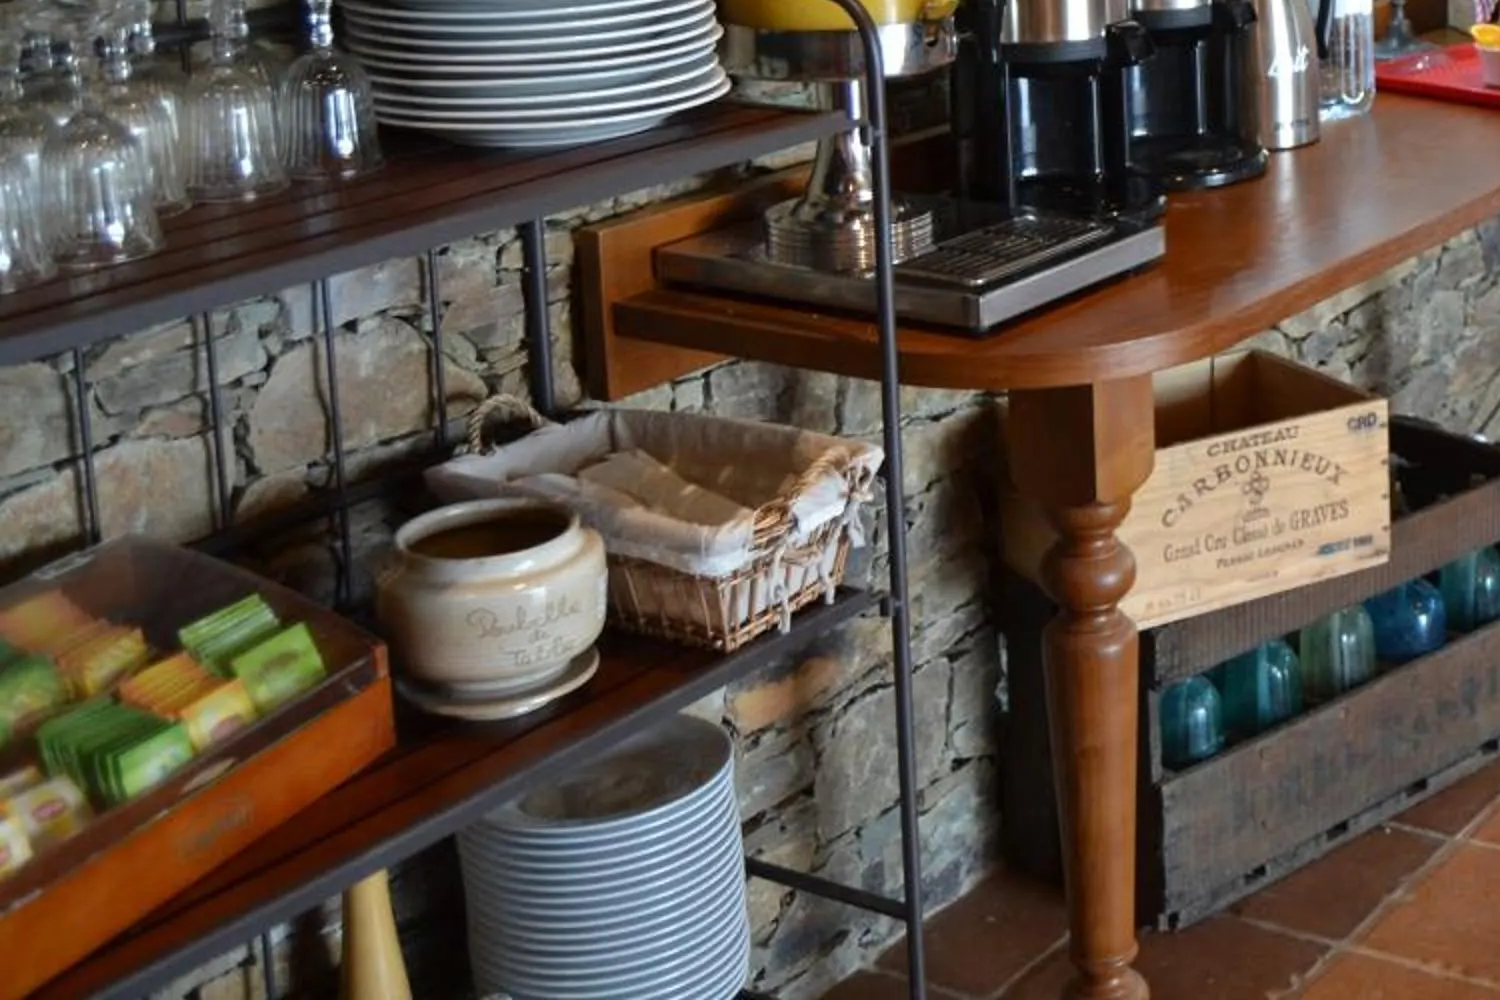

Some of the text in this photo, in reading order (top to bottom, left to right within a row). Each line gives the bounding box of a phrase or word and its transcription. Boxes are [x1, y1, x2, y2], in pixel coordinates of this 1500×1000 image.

[1206, 425, 1300, 458] CHATEAU
[1161, 448, 1349, 529] CARBONNIEUX
[1289, 499, 1350, 532] GRAVES
